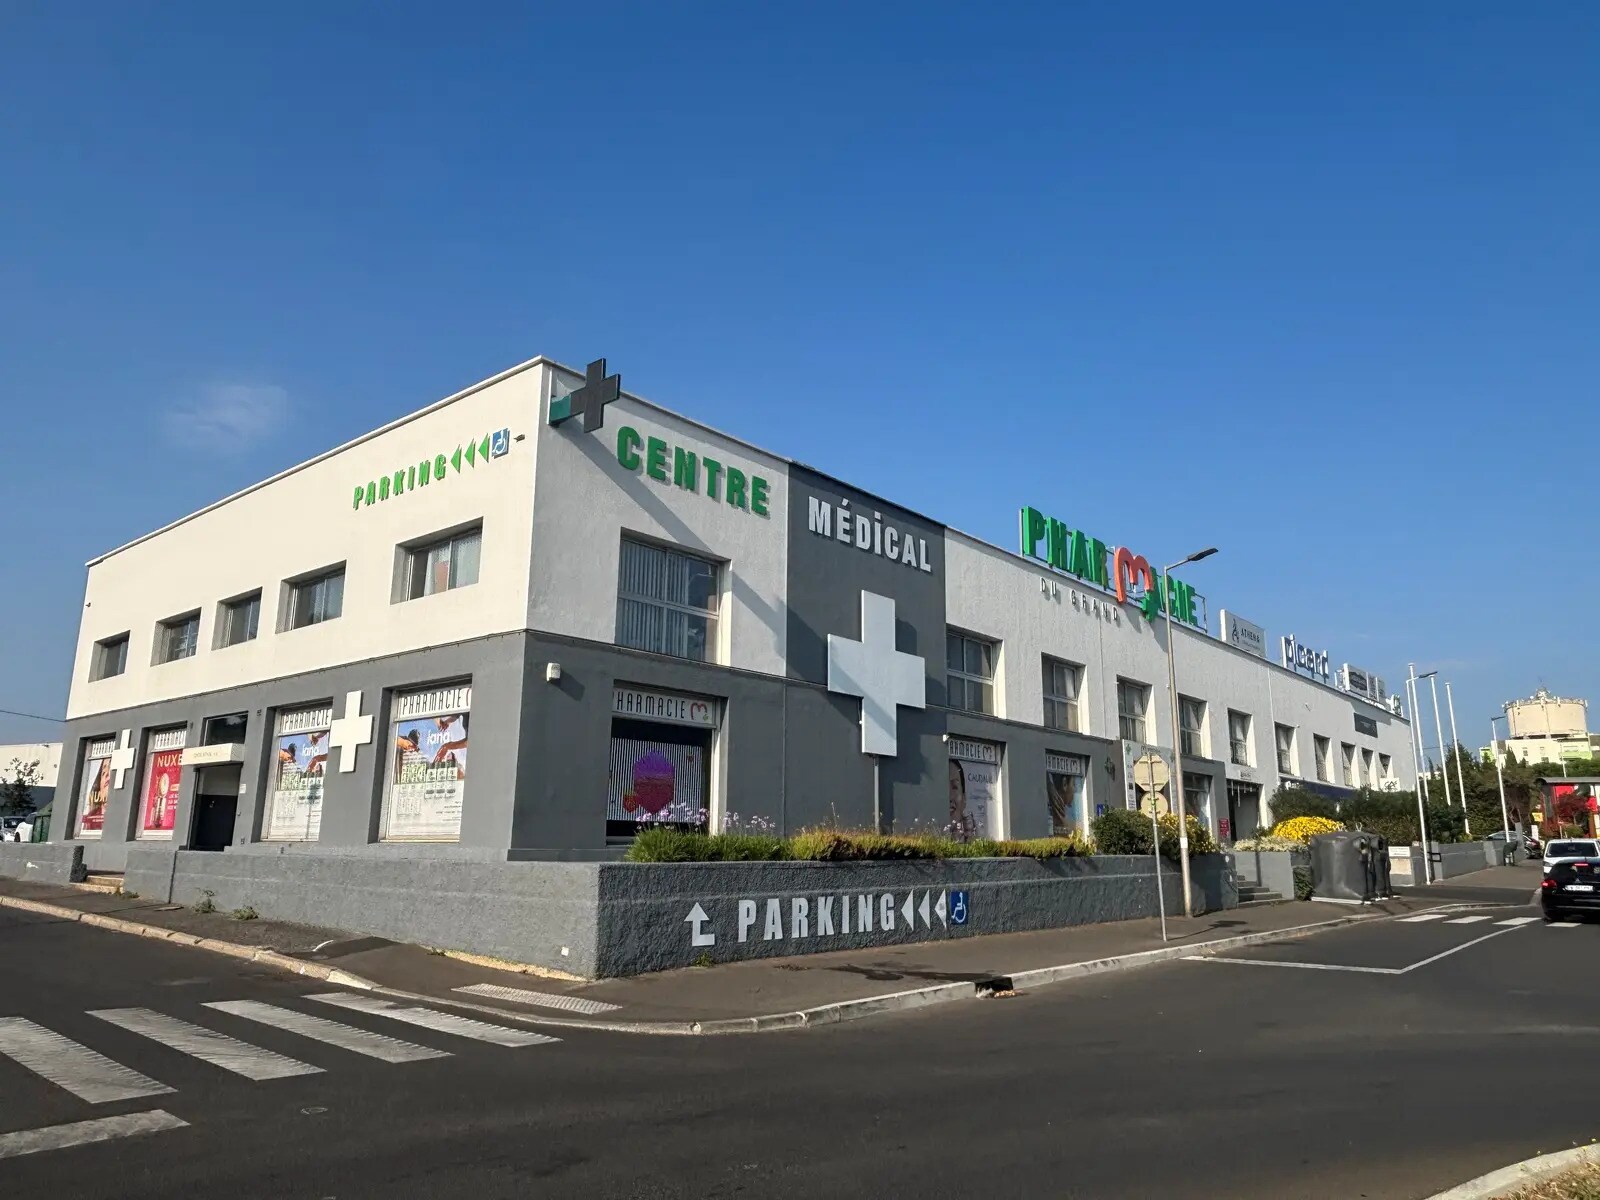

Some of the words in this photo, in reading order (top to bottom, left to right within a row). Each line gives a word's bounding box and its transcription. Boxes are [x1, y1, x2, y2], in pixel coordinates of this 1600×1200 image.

[353, 454, 446, 510] PARKING
[617, 426, 768, 516] CENTRE
[1040, 577, 1057, 596] DU
[1070, 589, 1118, 622] GRAND
[1281, 634, 1329, 681] picard
[402, 687, 461, 715] PHARMACIE
[613, 691, 686, 719] HARMACIE
[738, 893, 895, 942] PARKING
